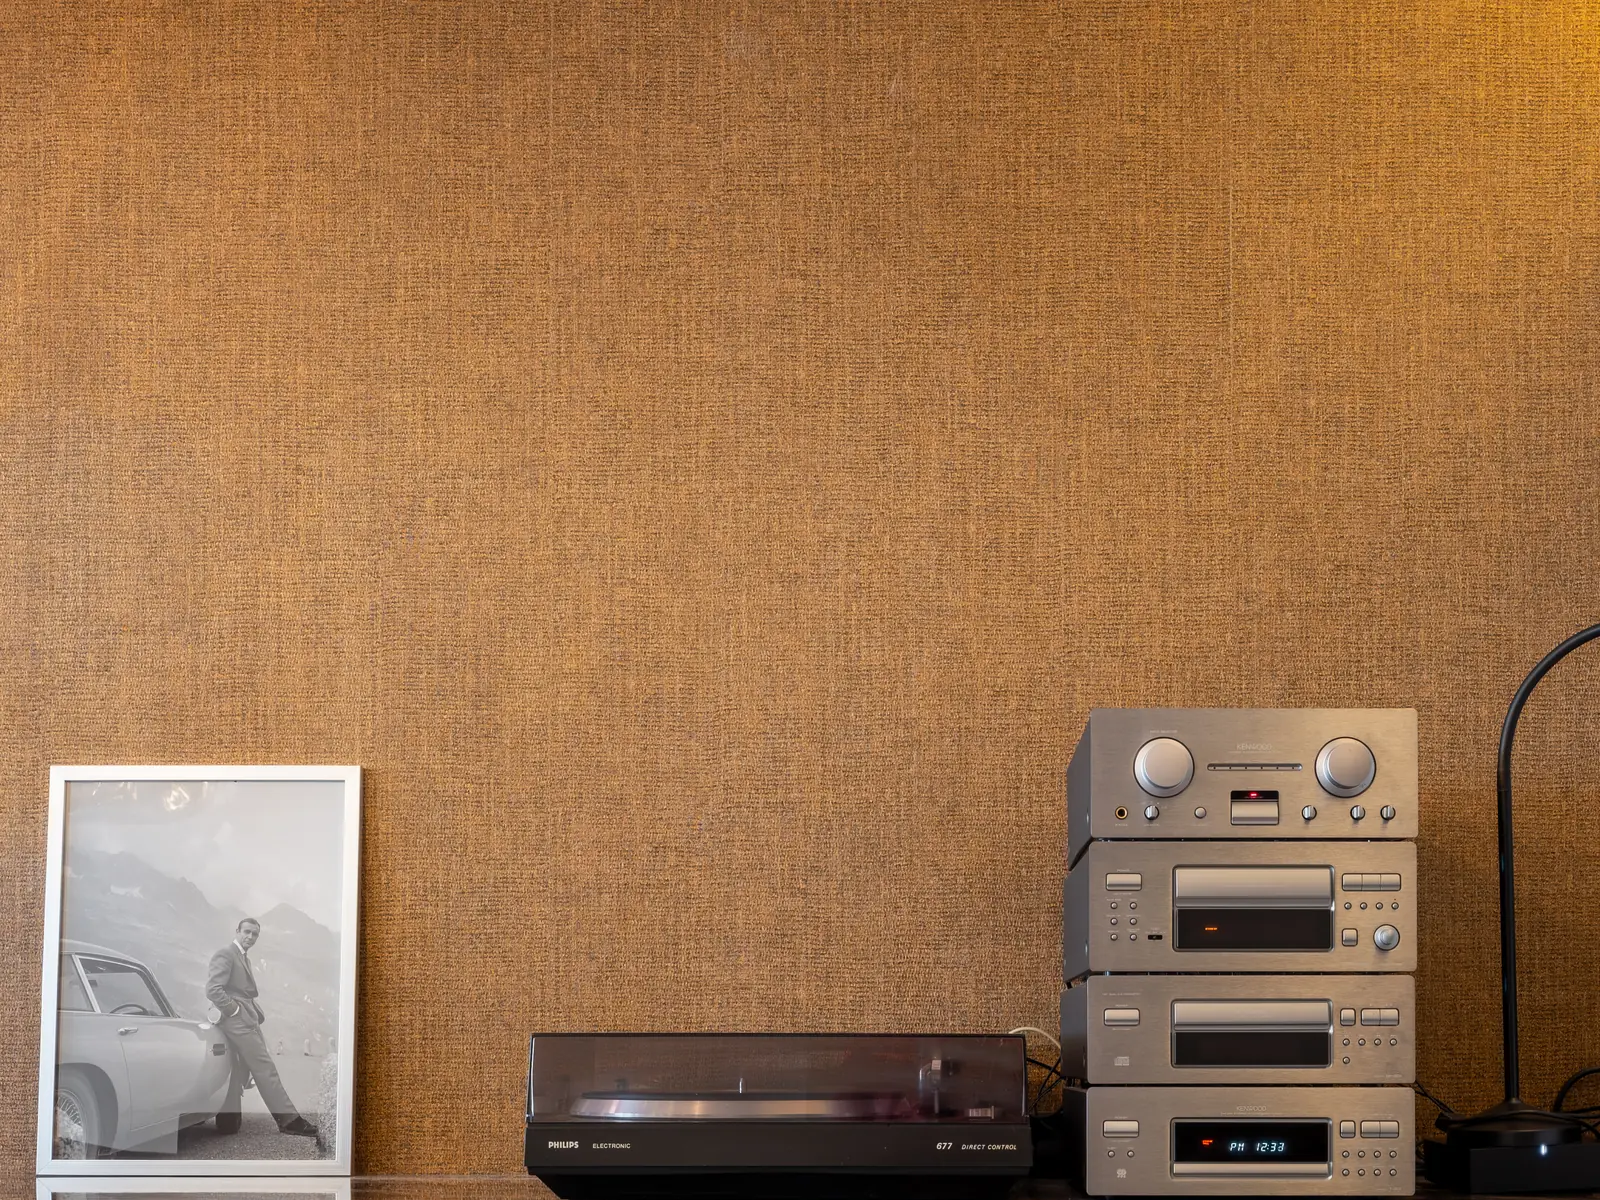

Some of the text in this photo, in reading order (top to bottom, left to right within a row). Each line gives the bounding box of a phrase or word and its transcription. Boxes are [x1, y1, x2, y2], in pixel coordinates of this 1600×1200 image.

[548, 1141, 579, 1149] PHILIPS
[936, 1142, 953, 1150] 677
[1229, 1142, 1245, 1152] PM
